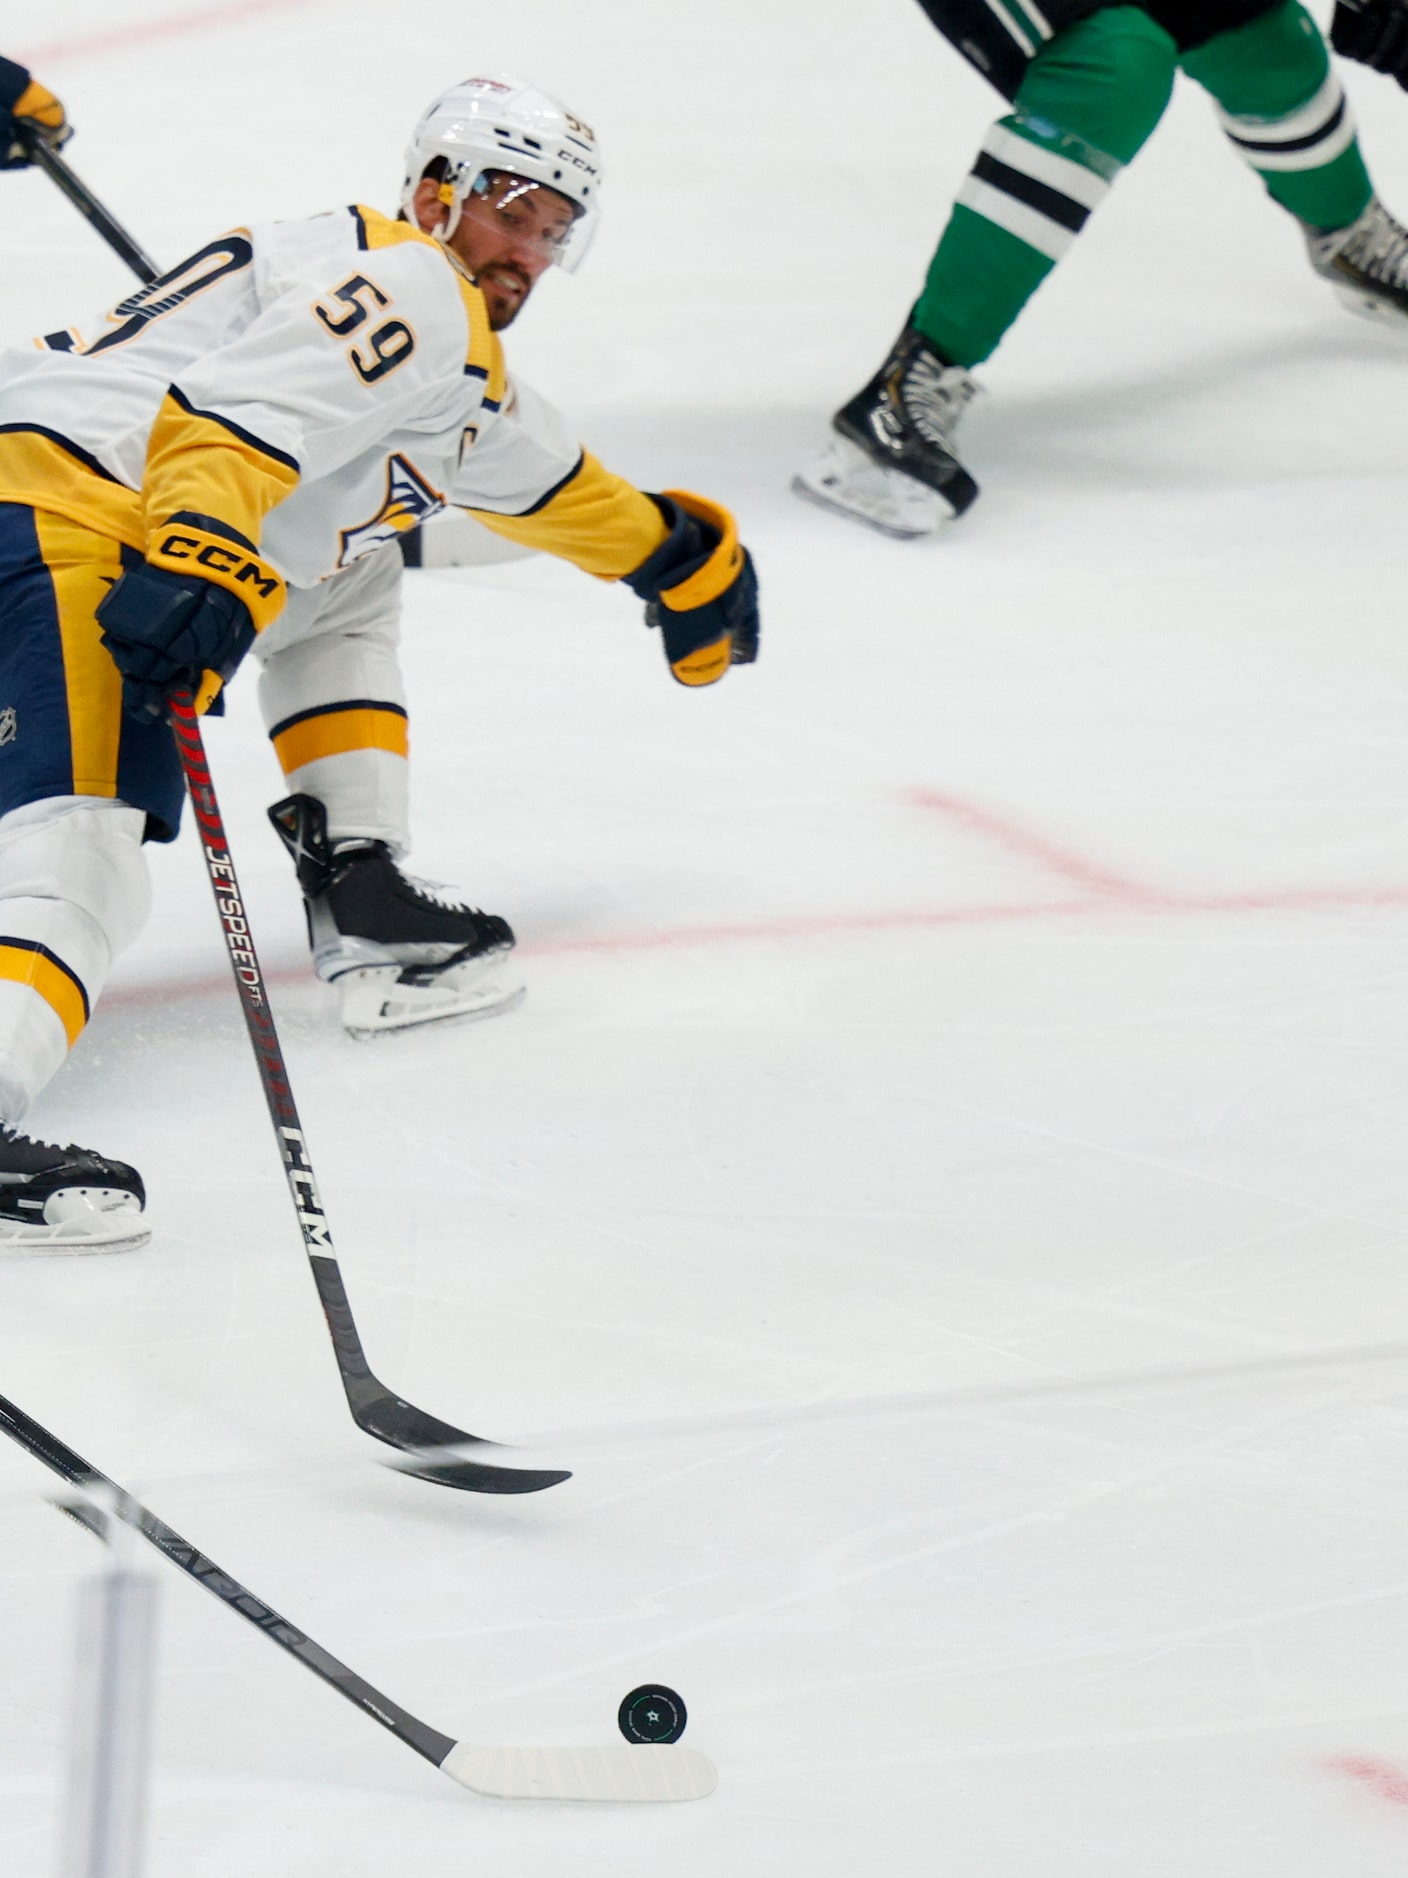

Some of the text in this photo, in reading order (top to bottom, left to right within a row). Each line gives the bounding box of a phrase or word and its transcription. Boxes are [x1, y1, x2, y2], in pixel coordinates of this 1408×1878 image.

[557, 150, 598, 176] CCM
[310, 270, 416, 387] 59
[159, 535, 279, 599] CCM
[206, 846, 264, 986] JETSPEED
[279, 1125, 338, 1261] CCM
